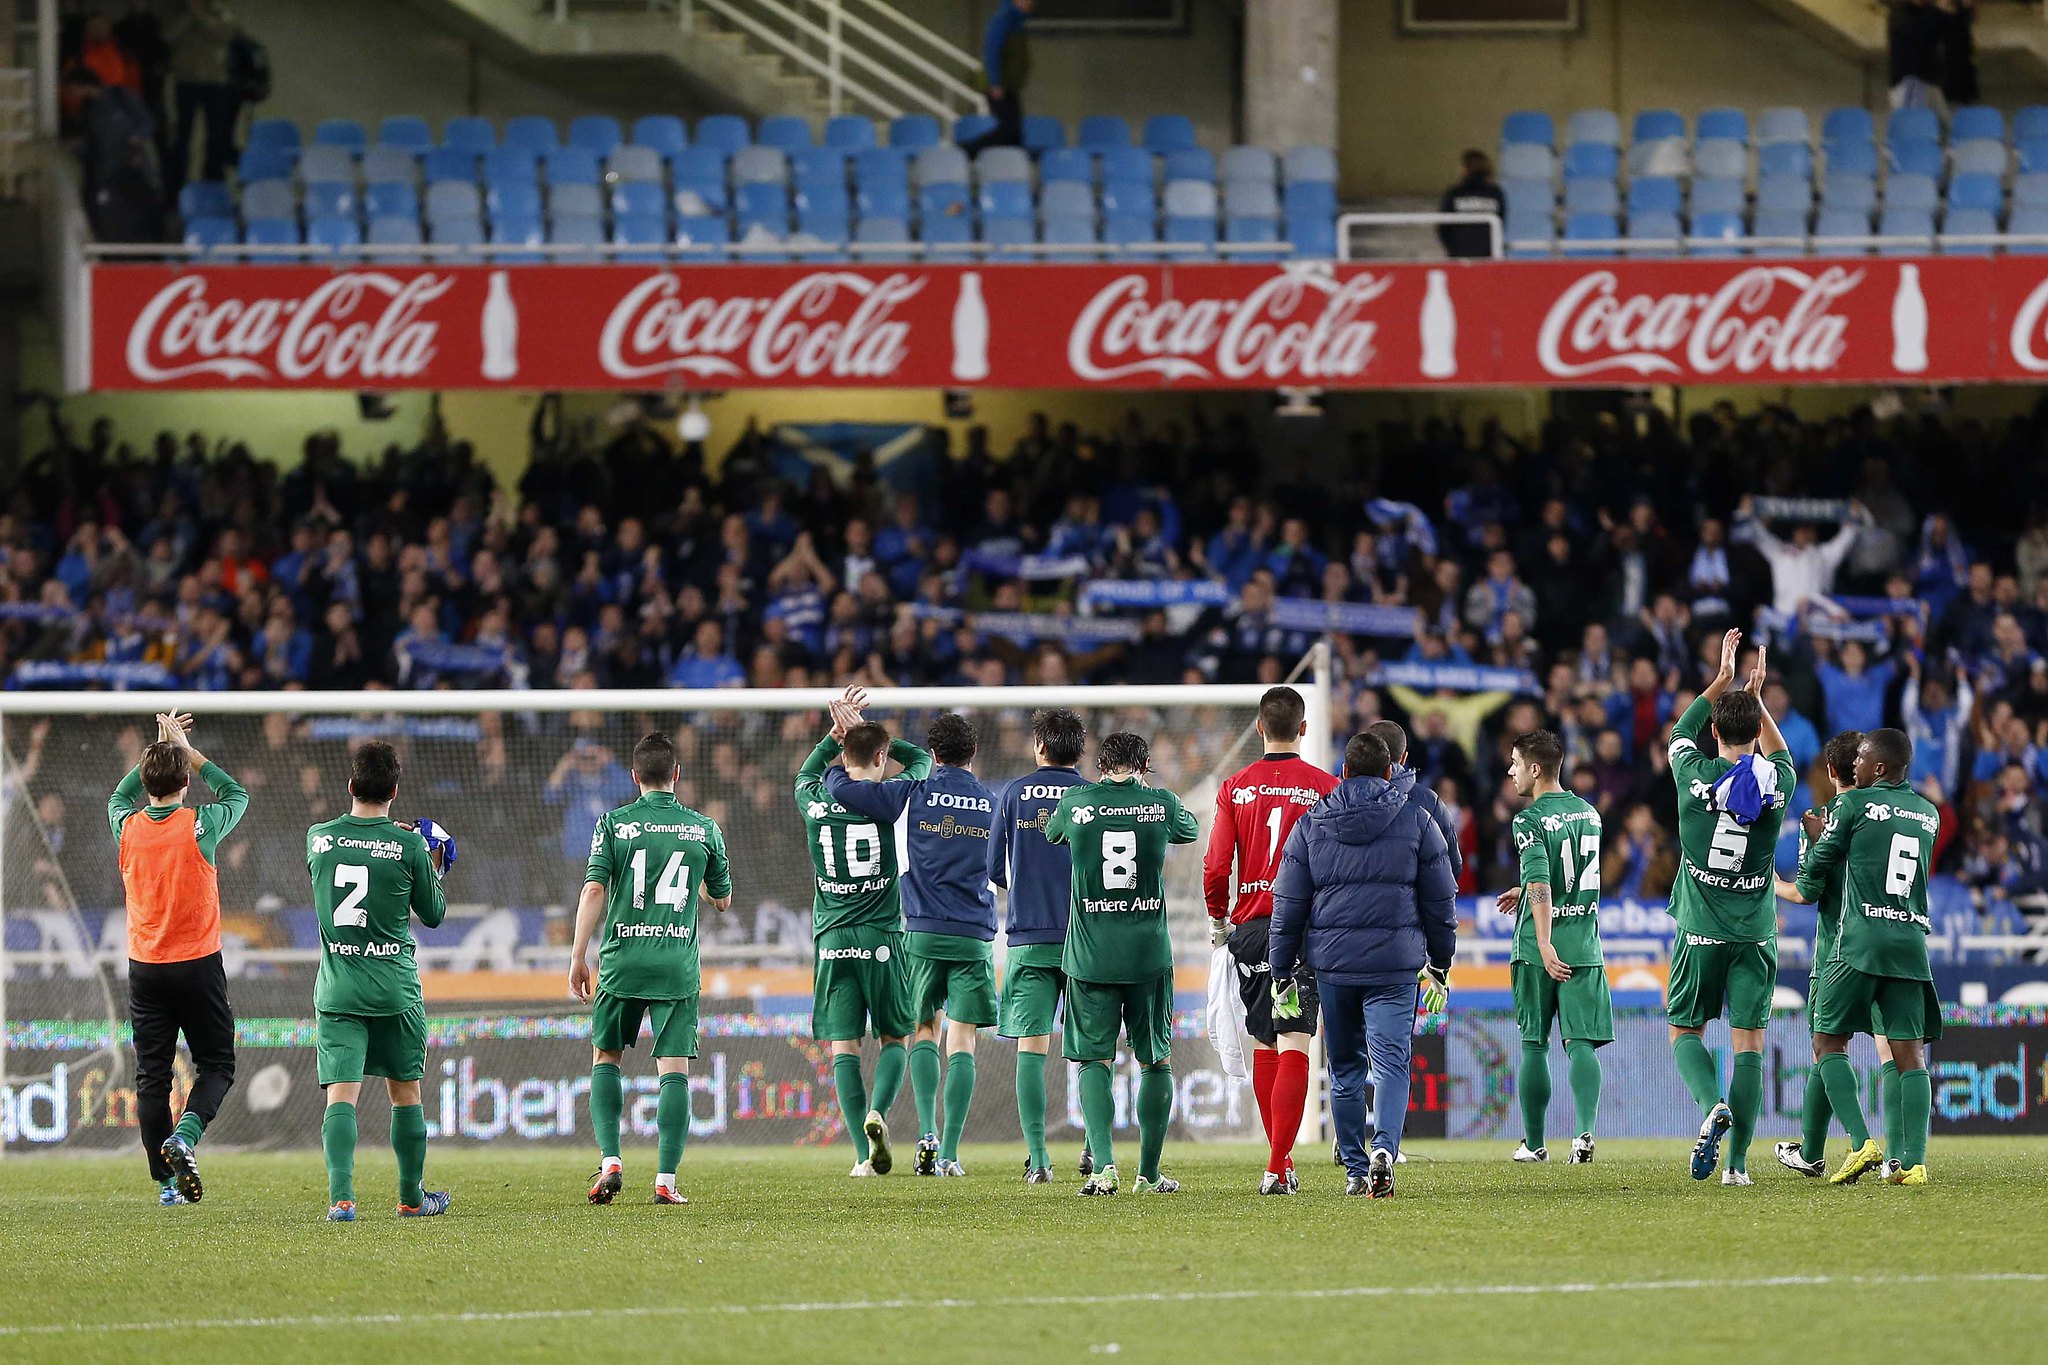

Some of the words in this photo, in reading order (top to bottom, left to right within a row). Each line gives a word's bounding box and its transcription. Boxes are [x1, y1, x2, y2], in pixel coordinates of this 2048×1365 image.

[1020, 785, 1067, 801] Jom
[926, 792, 992, 813] Joma
[1016, 818, 1038, 830] Real
[1136, 814, 1166, 823] GRUPO
[919, 821, 940, 833] Real
[677, 832, 706, 843] GRUPO
[1266, 806, 1282, 867] 1
[370, 849, 403, 861] GRUPO
[819, 822, 881, 878] 10
[1101, 830, 1138, 890] 8
[1560, 835, 1600, 893] 12
[1885, 832, 1920, 898] 6
[630, 848, 690, 913] 14
[1732, 875, 1766, 890] Auto
[333, 863, 369, 928] 2
[1082, 898, 1128, 913] Tartiere
[1130, 896, 1161, 912] Auto
[616, 922, 664, 938] Tartiere
[363, 941, 401, 957] Auto
